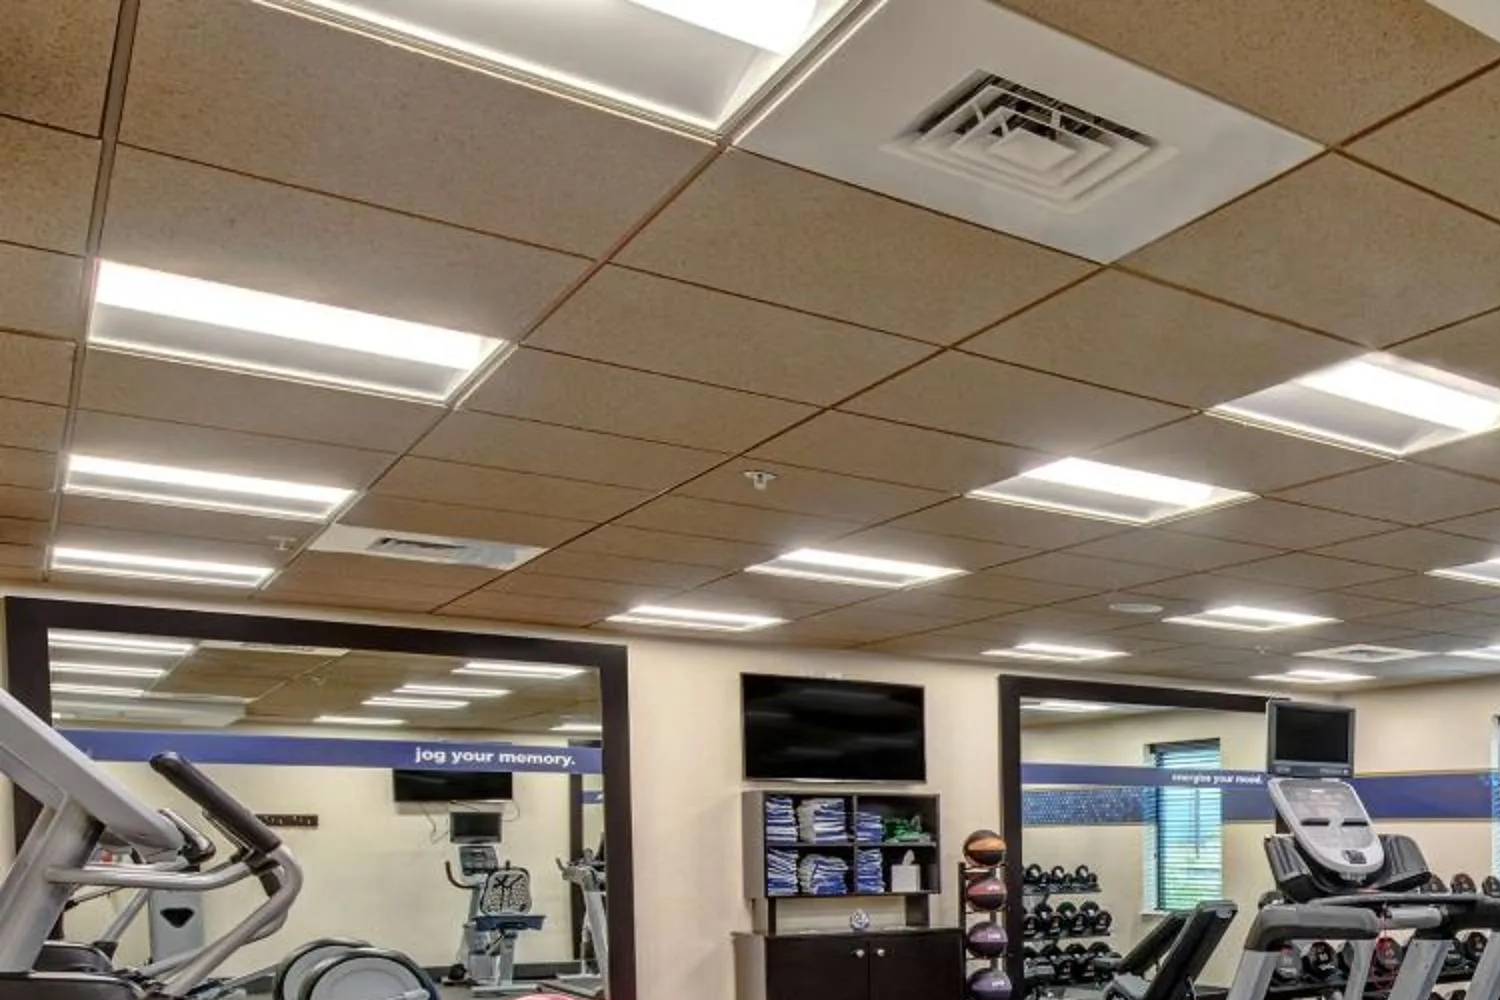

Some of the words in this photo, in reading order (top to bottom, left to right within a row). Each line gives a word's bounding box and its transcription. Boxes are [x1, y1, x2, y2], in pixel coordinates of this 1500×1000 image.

[415, 747, 446, 764] jog
[451, 751, 494, 765] your
[499, 752, 576, 767] memory.
